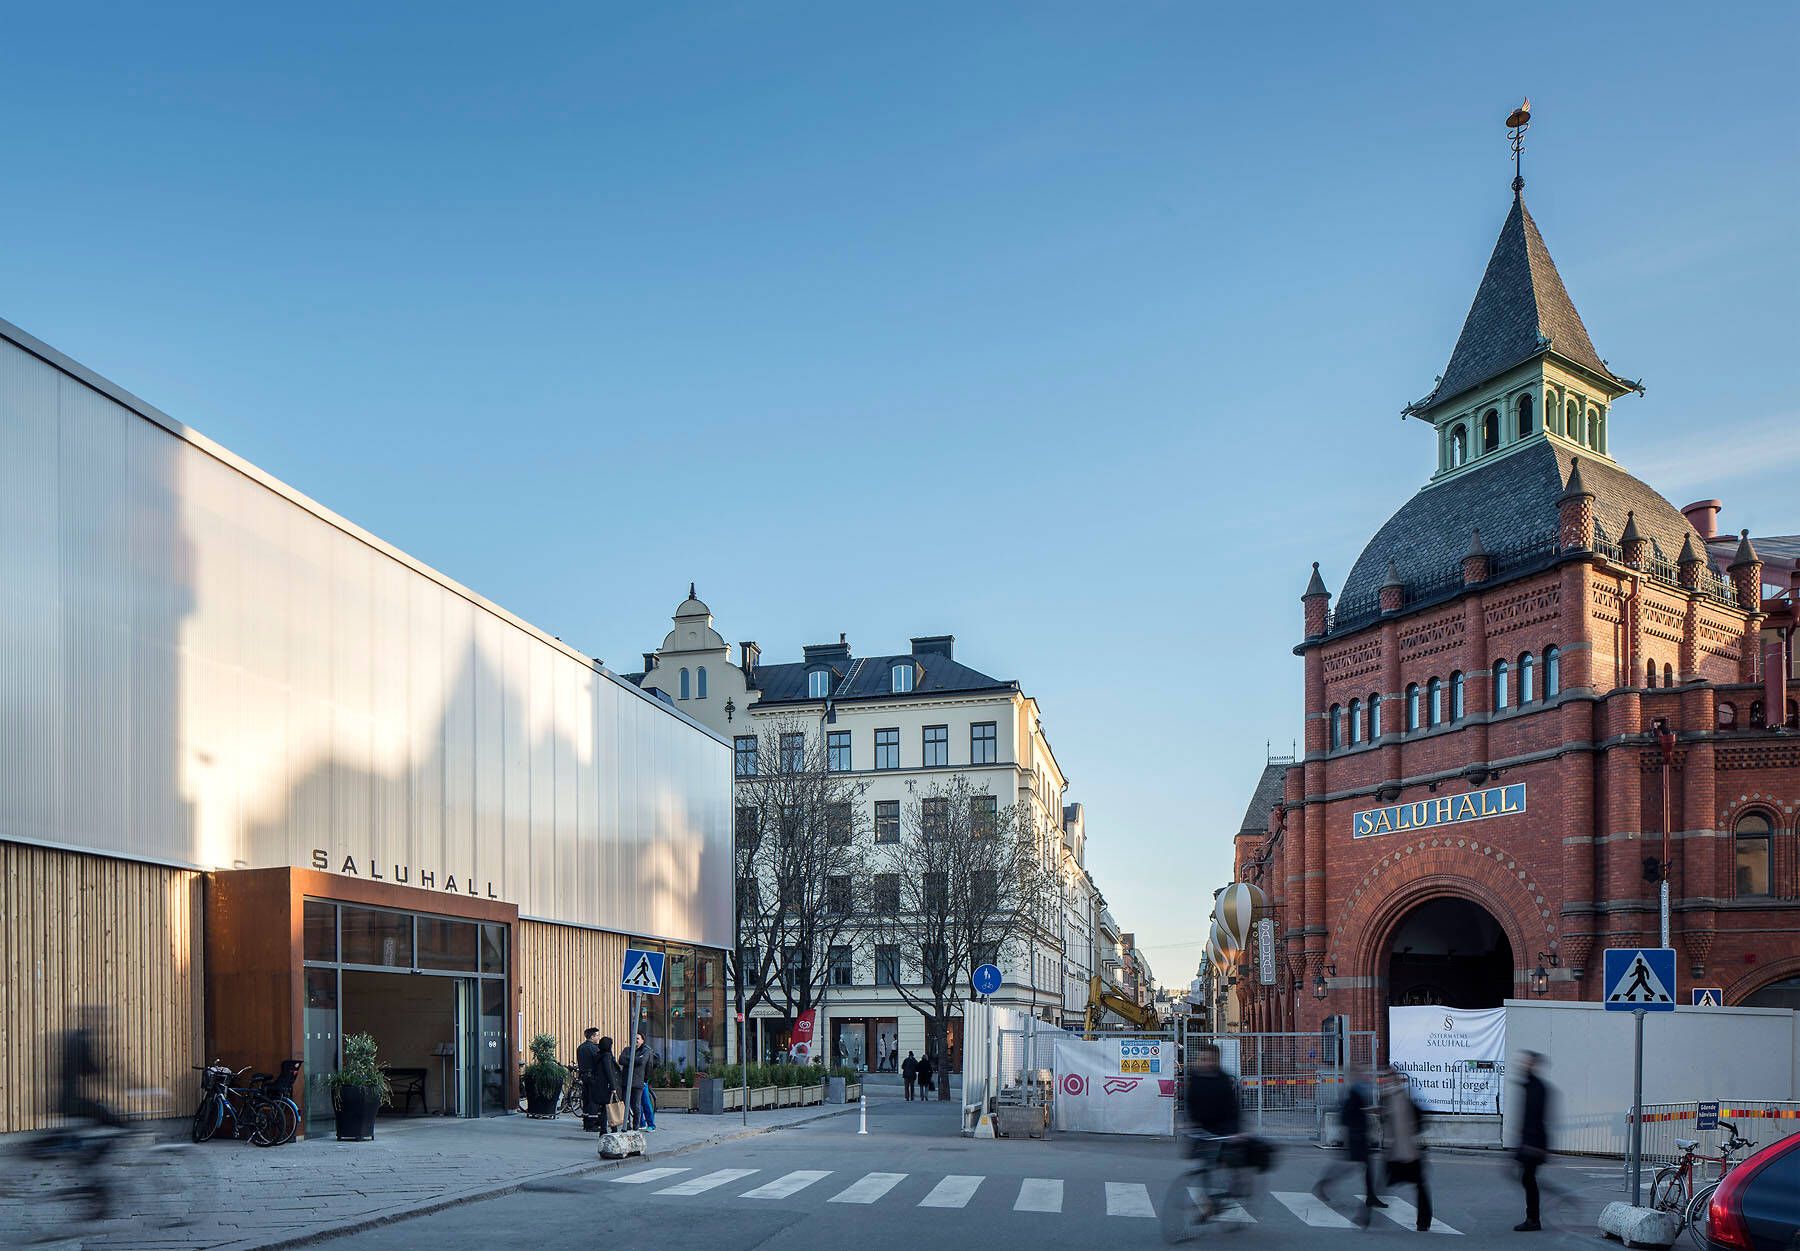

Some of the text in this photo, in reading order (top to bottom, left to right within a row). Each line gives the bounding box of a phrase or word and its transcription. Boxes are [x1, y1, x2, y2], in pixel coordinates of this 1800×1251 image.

[1358, 786, 1519, 835] SALUHALL
[311, 848, 498, 899] SALUHALL
[1261, 921, 1273, 982] SALUHALL
[1426, 1039, 1471, 1048] SALUHALL
[1393, 1061, 1442, 1073] Saluhallen
[1444, 1062, 1461, 1073] har
[1411, 1077, 1439, 1090] flyttat
